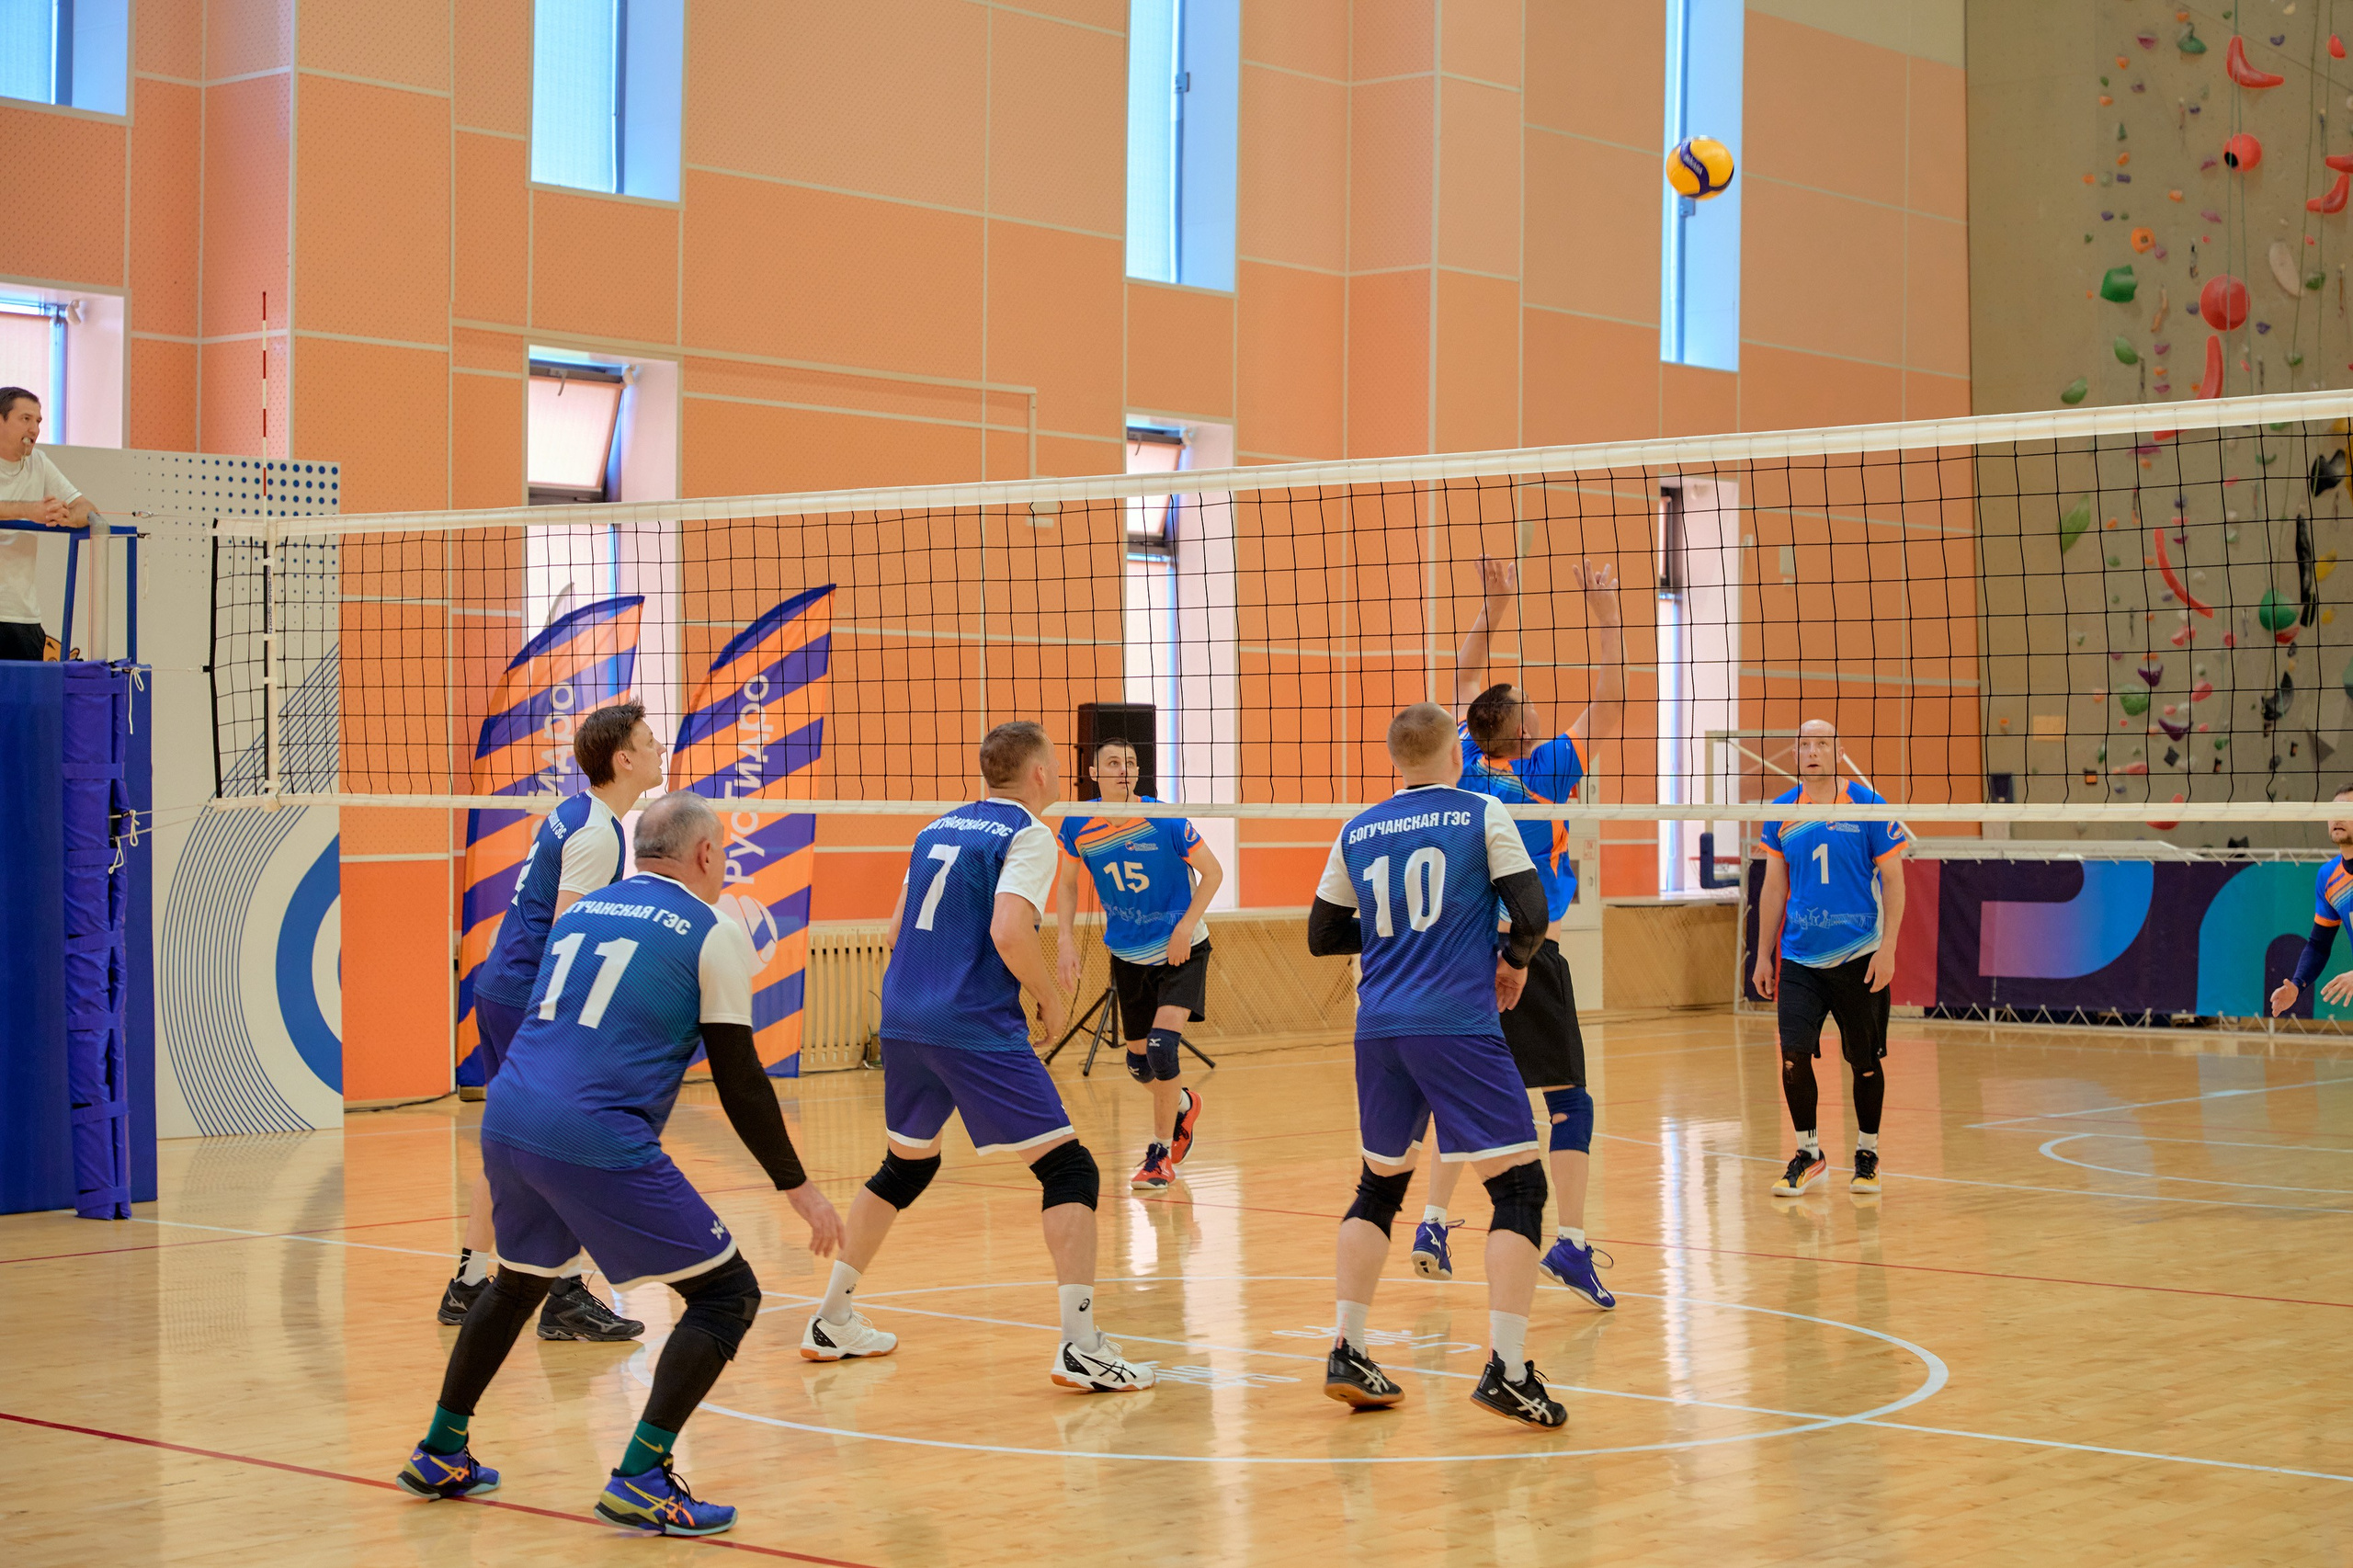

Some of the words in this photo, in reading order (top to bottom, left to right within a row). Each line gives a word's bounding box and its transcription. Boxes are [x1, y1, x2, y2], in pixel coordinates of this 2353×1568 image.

[526, 681, 576, 842] идро
[984, 822, 1014, 837] ГЭС
[1348, 812, 1439, 845] БОГУЧАНСКАЯ
[1443, 811, 1472, 826] ГЭС
[1103, 860, 1150, 893] 15
[1812, 843, 1829, 884] 1
[915, 844, 961, 931] 7
[1363, 846, 1446, 937] 10
[558, 901, 655, 920] ГУЧАНСКАЯ
[653, 908, 692, 936] ГЭС
[538, 933, 640, 1028] 11
